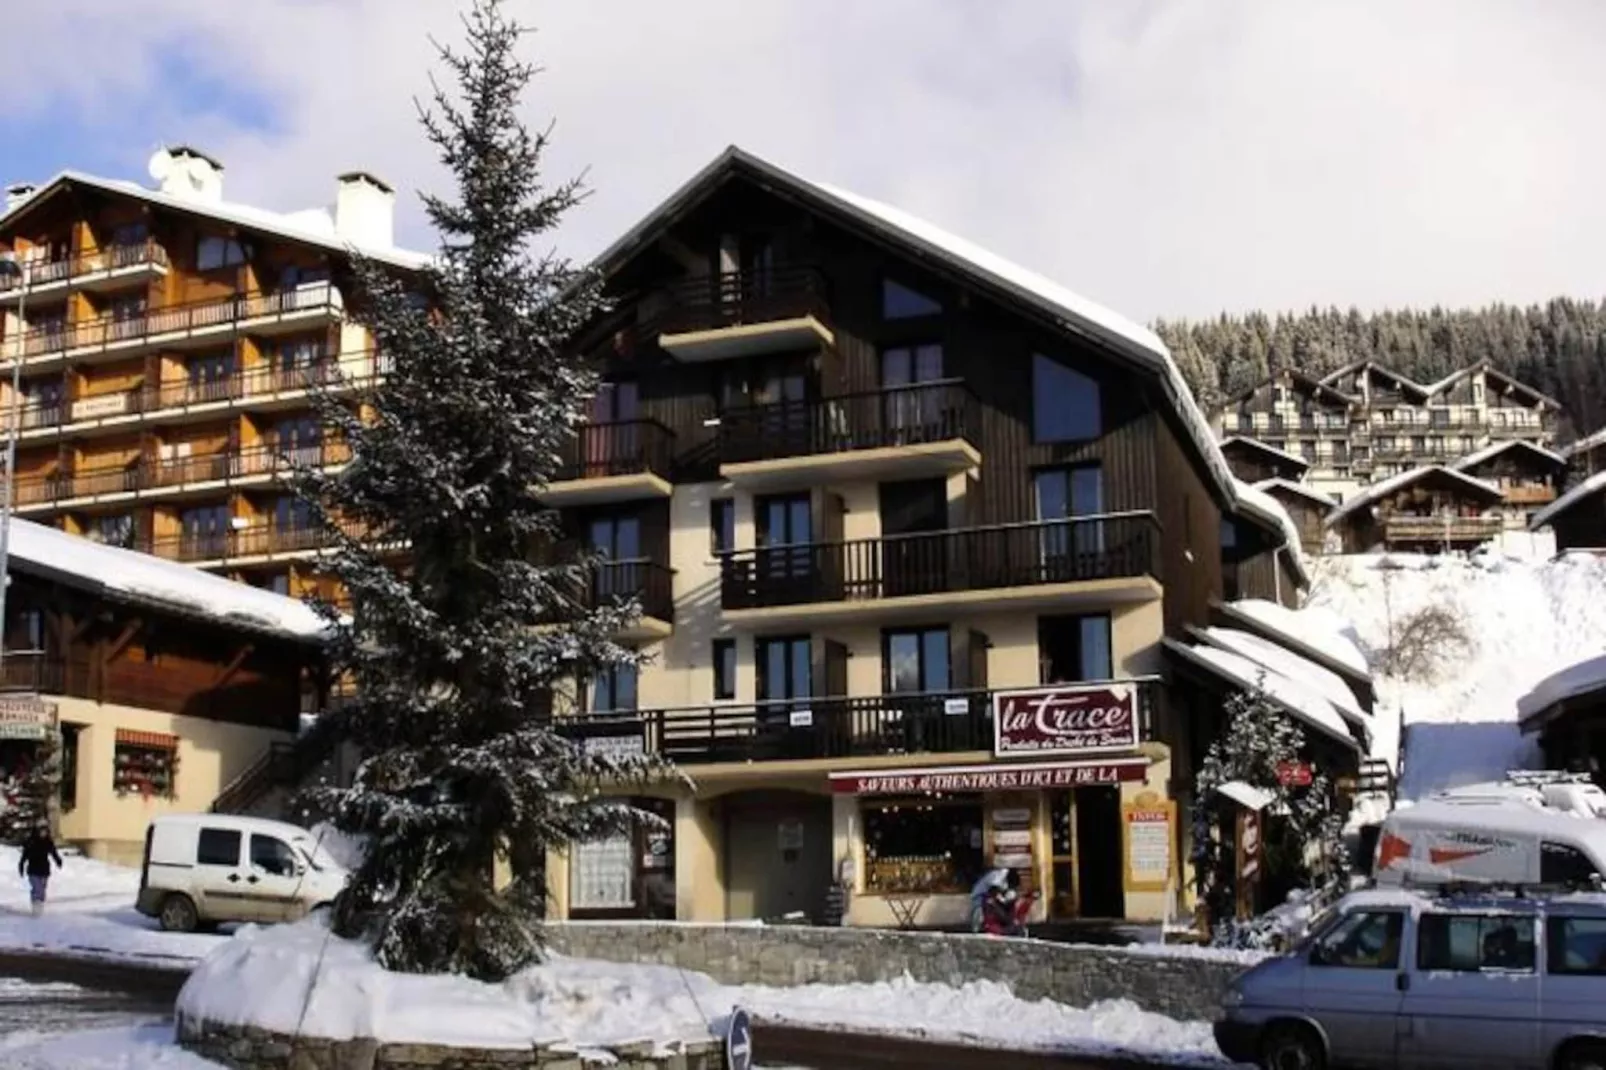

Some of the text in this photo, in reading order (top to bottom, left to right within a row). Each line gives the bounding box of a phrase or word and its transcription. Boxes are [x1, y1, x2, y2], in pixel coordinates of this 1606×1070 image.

[1003, 695, 1129, 735] la Trace
[857, 776, 914, 792] SAVEURS
[920, 772, 1017, 789] AUTHENTIQUES
[1055, 769, 1073, 784] ET
[1076, 768, 1096, 782] DE
[1099, 767, 1118, 781] LA
